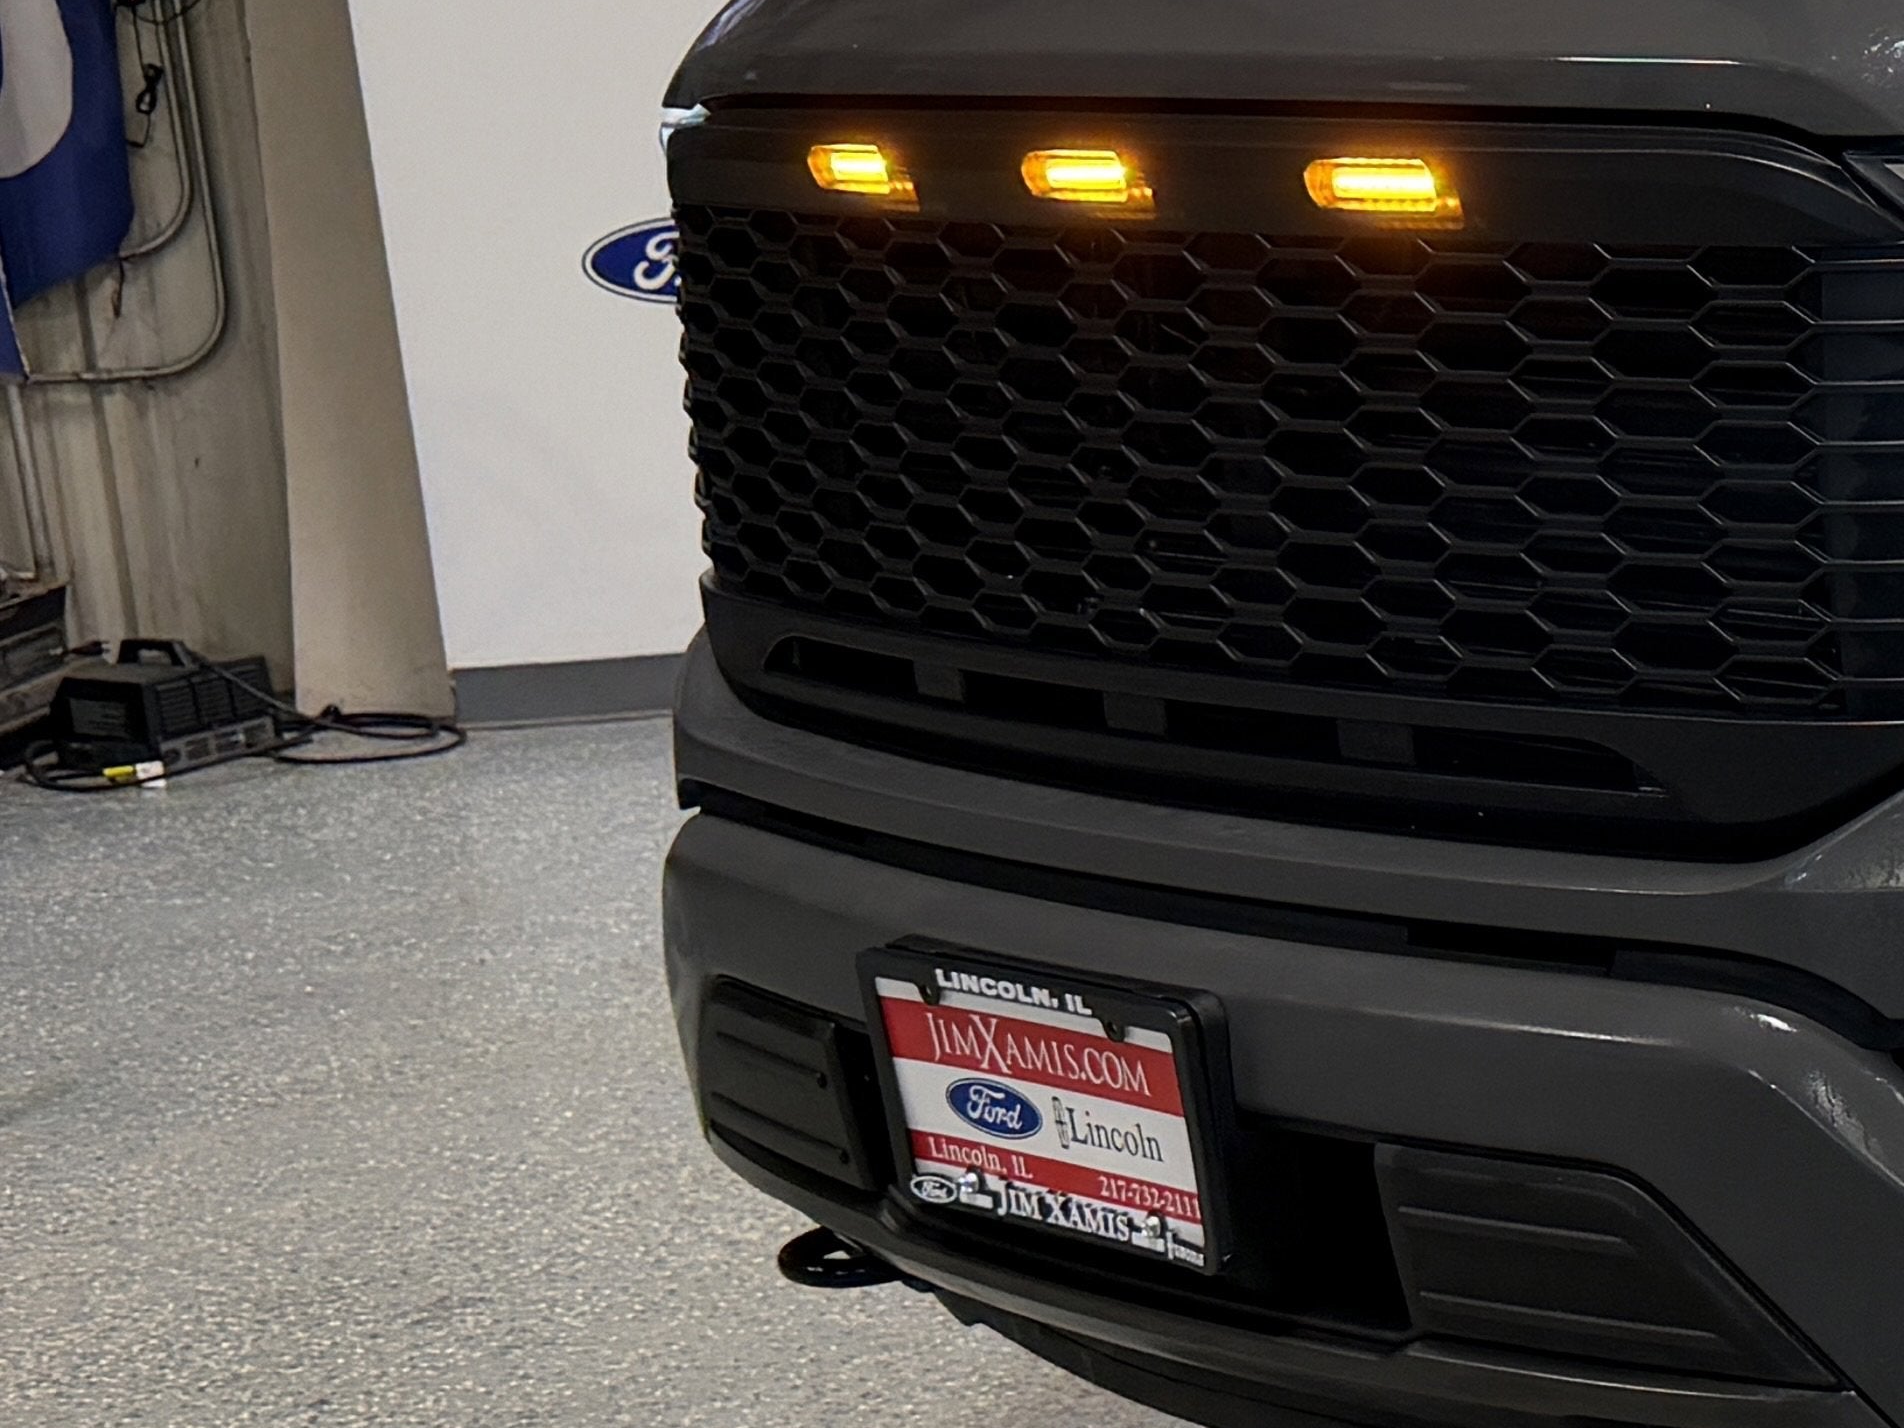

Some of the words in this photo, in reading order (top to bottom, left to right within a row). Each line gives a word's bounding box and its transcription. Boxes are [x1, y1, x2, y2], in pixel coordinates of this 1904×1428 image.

[934, 968, 1058, 1010] LINCOLN,
[1064, 992, 1093, 1017] IL
[925, 1012, 1151, 1097] JIMXAMIS.COM
[967, 1084, 1023, 1131] Ford
[1067, 1107, 1164, 1163] Lincoln
[1011, 1153, 1034, 1180] IL
[1099, 1174, 1202, 1220] 217-732-2111
